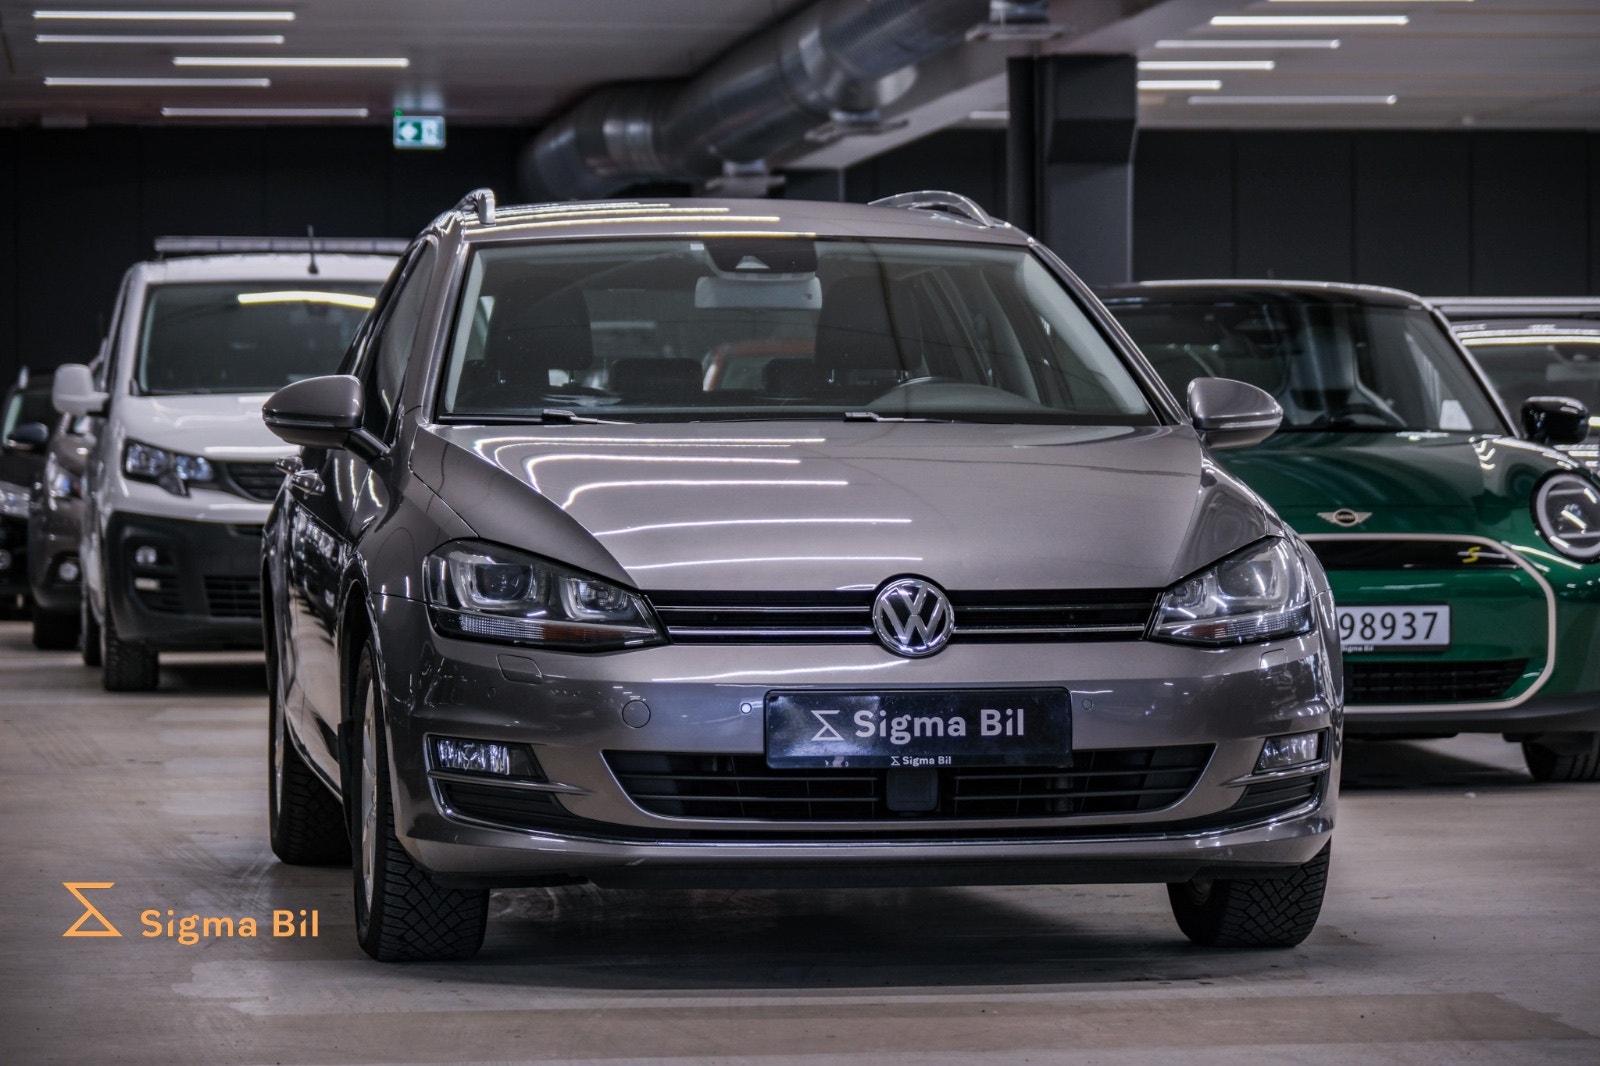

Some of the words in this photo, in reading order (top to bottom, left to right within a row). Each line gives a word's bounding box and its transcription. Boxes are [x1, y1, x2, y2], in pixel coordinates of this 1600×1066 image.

[1462, 546, 1481, 563] S
[877, 581, 951, 651] VW
[1340, 612, 1438, 640] 98937
[853, 709, 967, 745] Sigma
[980, 708, 1025, 737] Bil
[902, 755, 935, 767] Sigma
[937, 755, 952, 765] Bil
